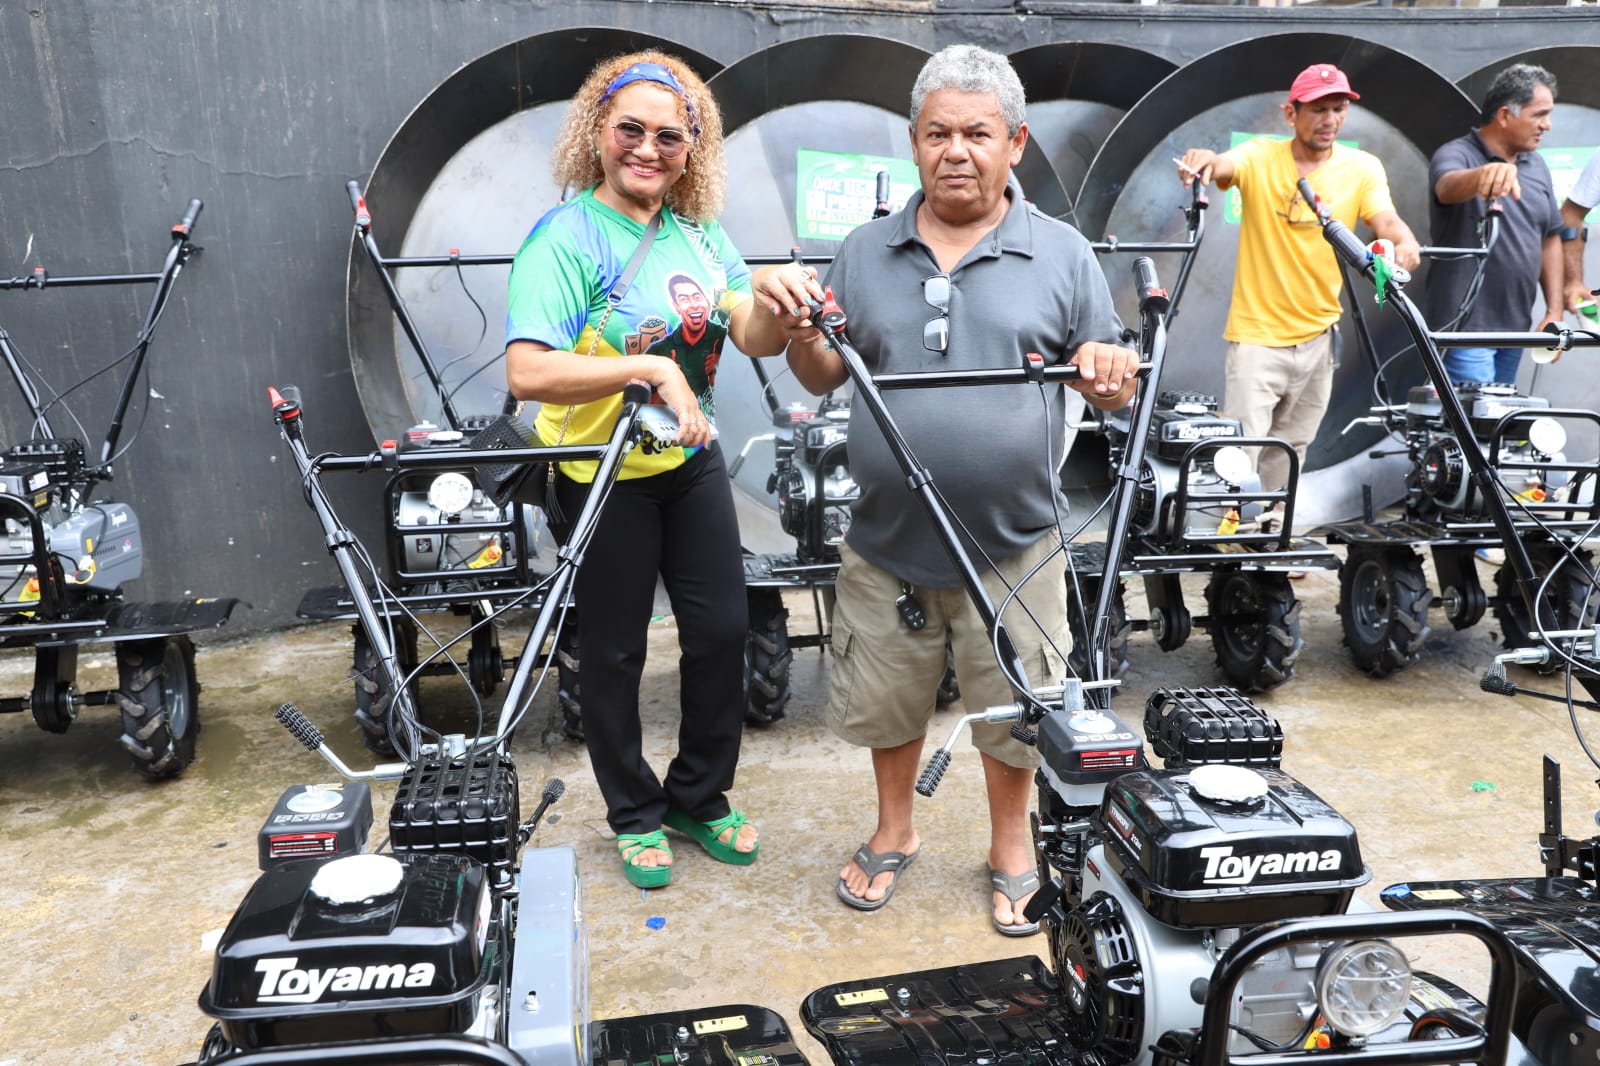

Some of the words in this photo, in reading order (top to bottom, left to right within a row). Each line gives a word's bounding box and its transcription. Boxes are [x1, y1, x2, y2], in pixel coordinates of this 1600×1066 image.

[1177, 423, 1235, 439] Toyama
[1199, 846, 1342, 885] Toyama
[255, 957, 436, 1003] Toyama
